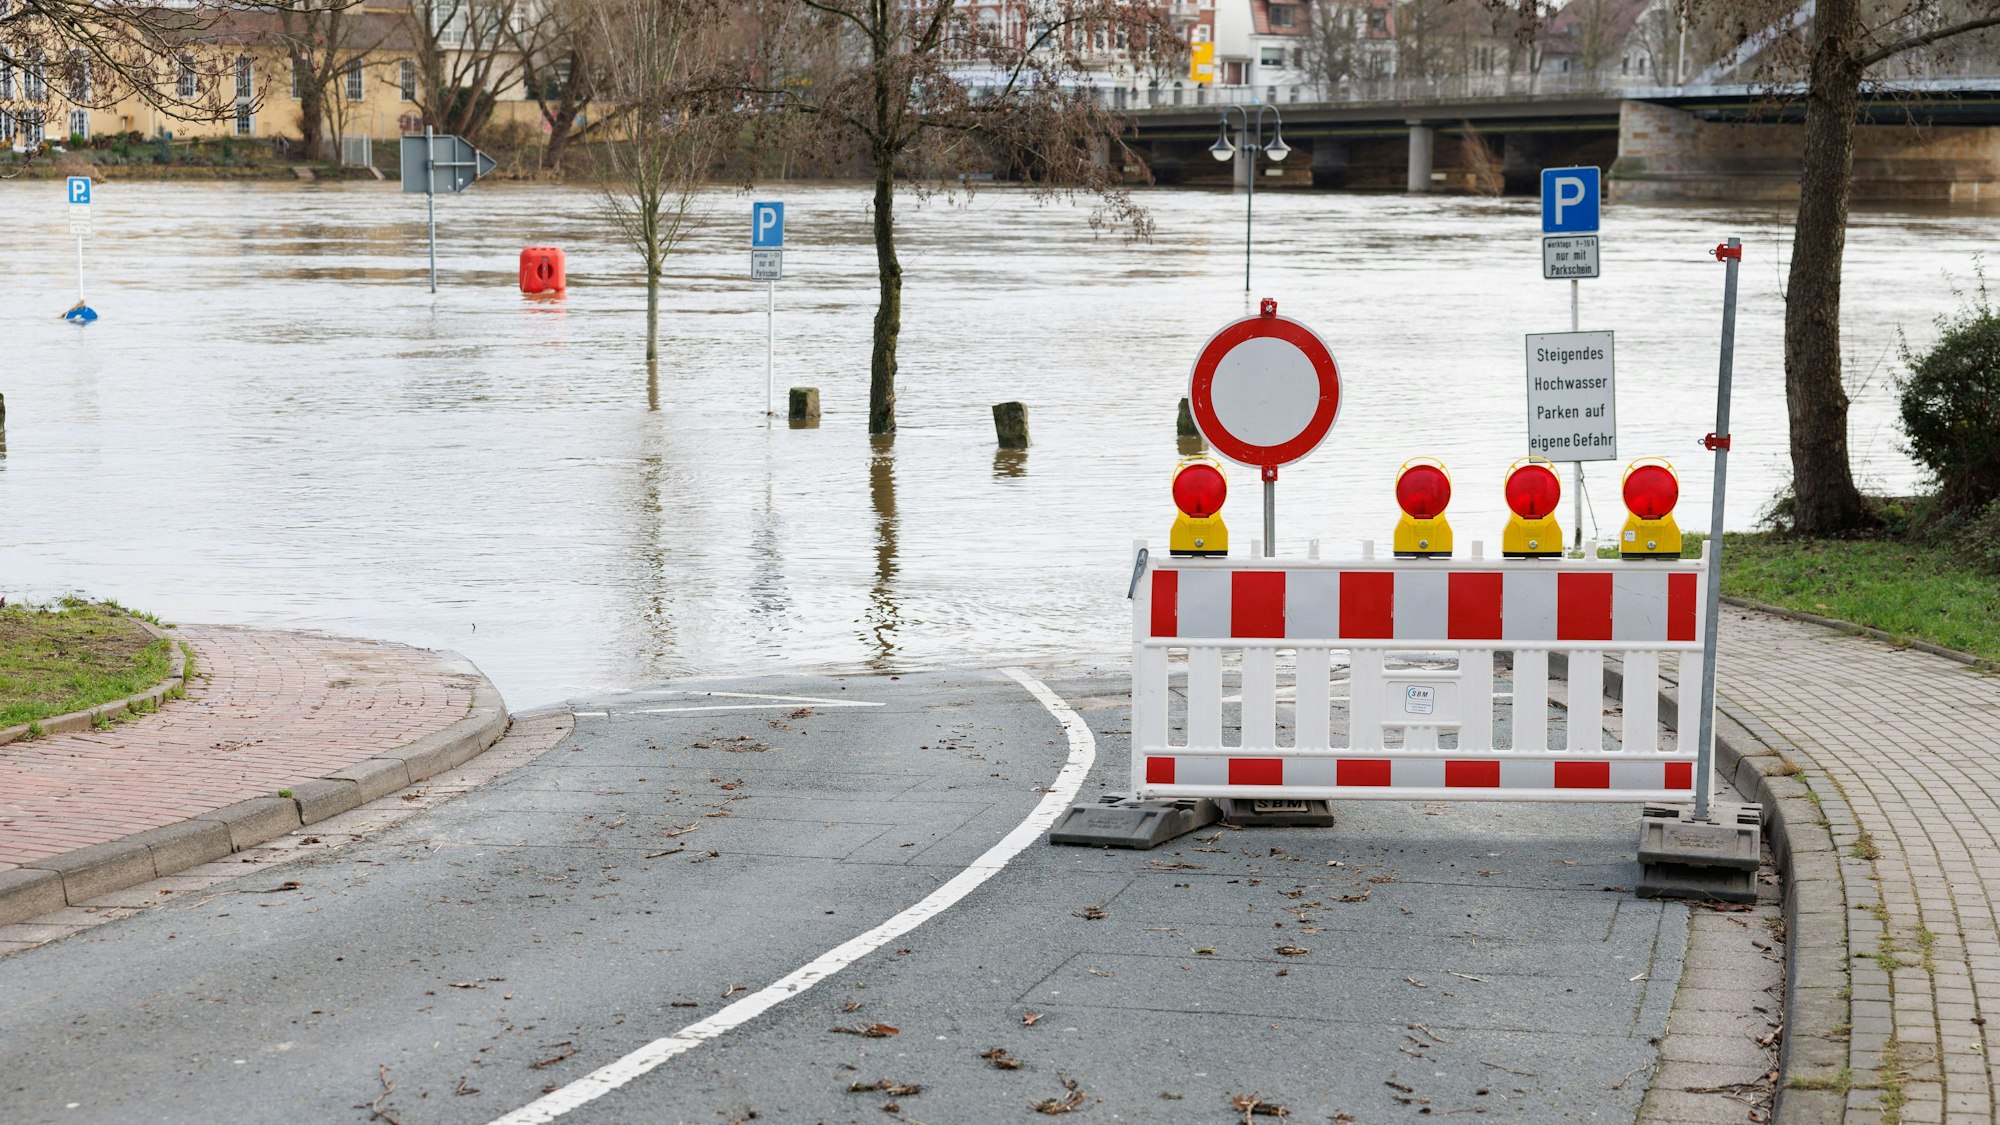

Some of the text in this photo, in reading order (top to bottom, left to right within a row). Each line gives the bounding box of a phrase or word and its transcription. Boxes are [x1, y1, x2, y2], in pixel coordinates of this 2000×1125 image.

[72, 180, 86, 202] P
[1555, 176, 1586, 225] P
[759, 207, 777, 242] P
[1556, 250, 1587, 261] nur mit
[1551, 263, 1592, 276] Parkschein
[1537, 346, 1604, 365] Steigendes
[1535, 376, 1608, 391] Hochwasser
[1537, 403, 1605, 419] Parken auf
[1531, 432, 1614, 451] eigene Gefahr
[1411, 690, 1429, 698] SBM
[1257, 799, 1303, 808] SBM
